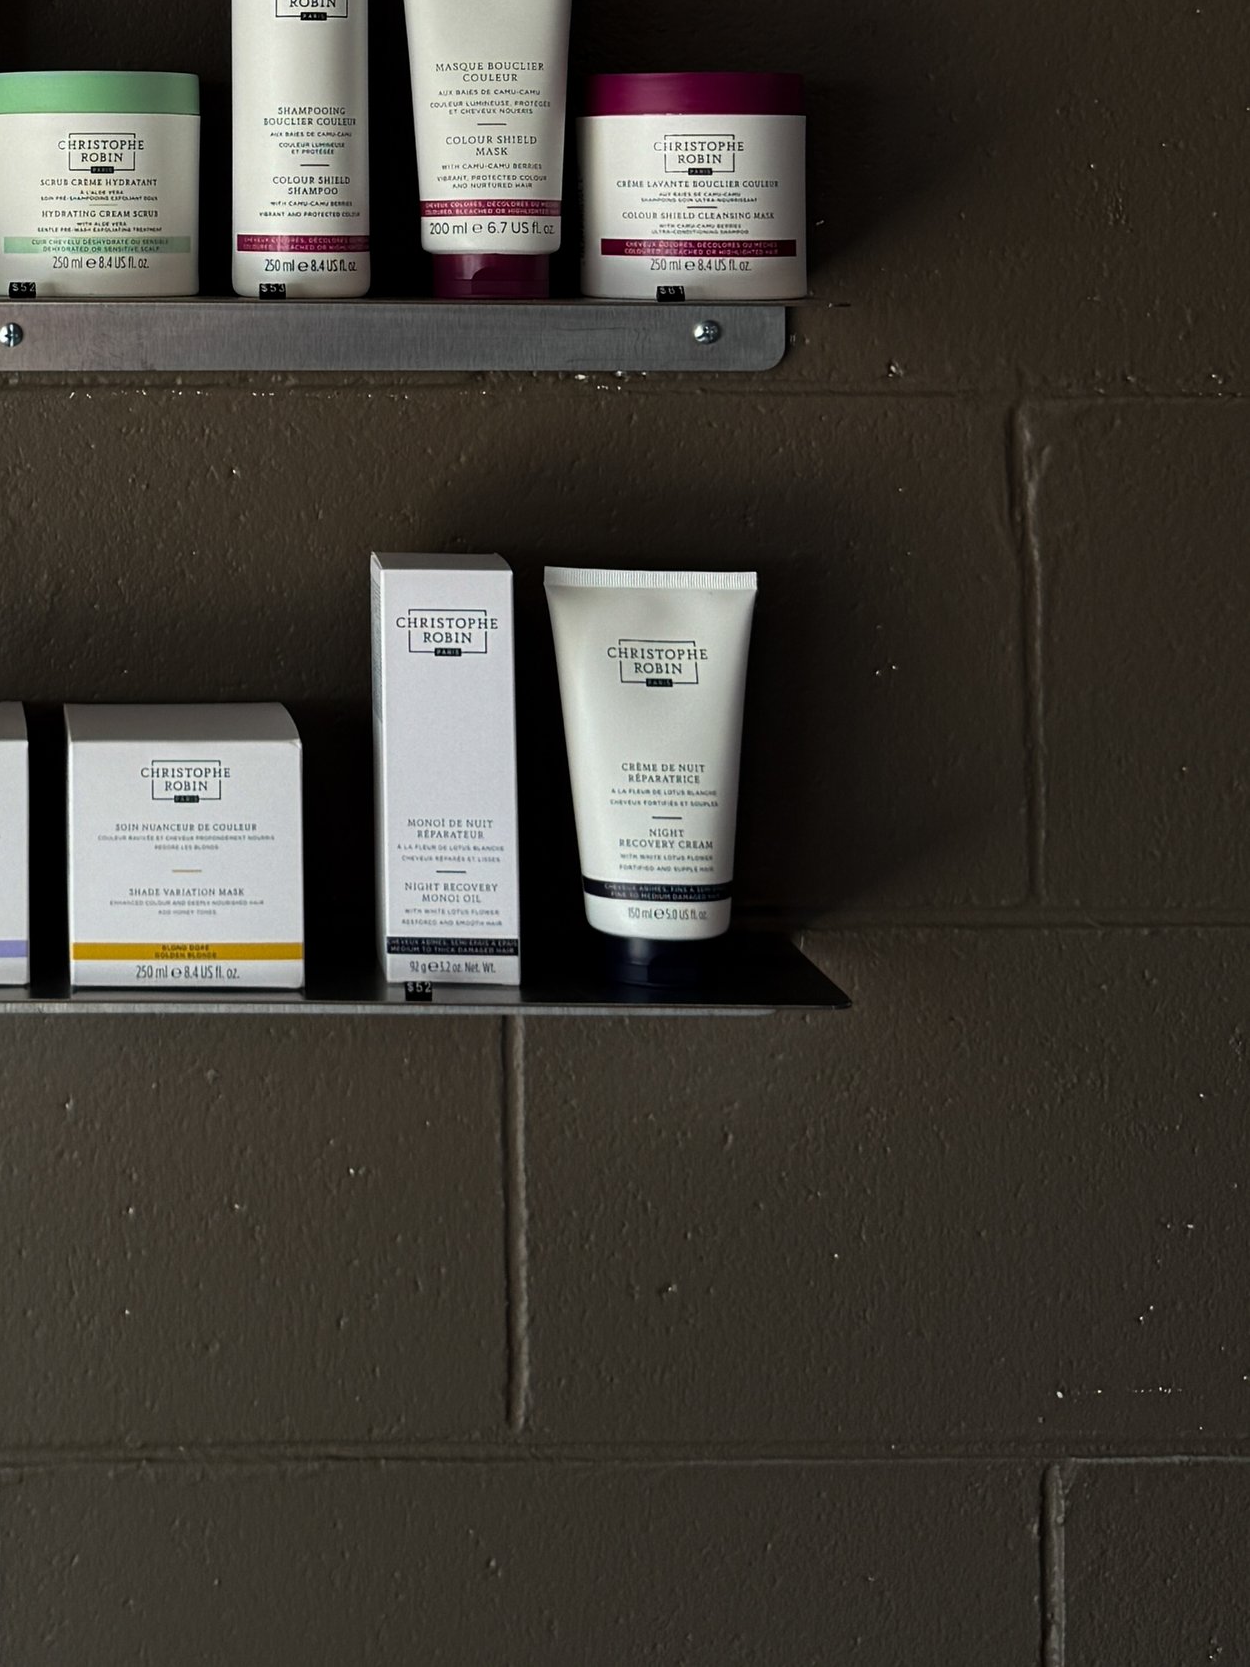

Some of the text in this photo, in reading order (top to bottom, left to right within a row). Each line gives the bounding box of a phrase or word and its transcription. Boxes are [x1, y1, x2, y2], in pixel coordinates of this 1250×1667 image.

[436, 62, 544, 72] MASQUE BOUCLIER
[463, 74, 518, 82] COULEUR
[58, 140, 144, 150] CHRISTOPHE
[446, 136, 537, 145] COLOUR SHIELD
[654, 142, 744, 151] CHRISTOPHE
[476, 148, 508, 156] MASK
[81, 153, 123, 162] ROBIN
[678, 154, 722, 163] ROBIN
[396, 617, 498, 629] CHRISTOPHE
[423, 632, 472, 643] ROBIN
[607, 647, 708, 660] CHRISTOPHE
[634, 662, 682, 674] ROBIN
[661, 763, 675, 772] DE
[678, 764, 705, 772] NUIT
[141, 768, 230, 778] CHRISTOPHE
[165, 781, 208, 792] ROBIN
[449, 819, 462, 827] DE
[466, 819, 493, 828] NUIT
[649, 828, 684, 837] NIGHT
[619, 839, 713, 849] RECOVERY CREAM
[405, 883, 498, 892] NIGHT RECOVERY
[463, 894, 481, 903] OIL
